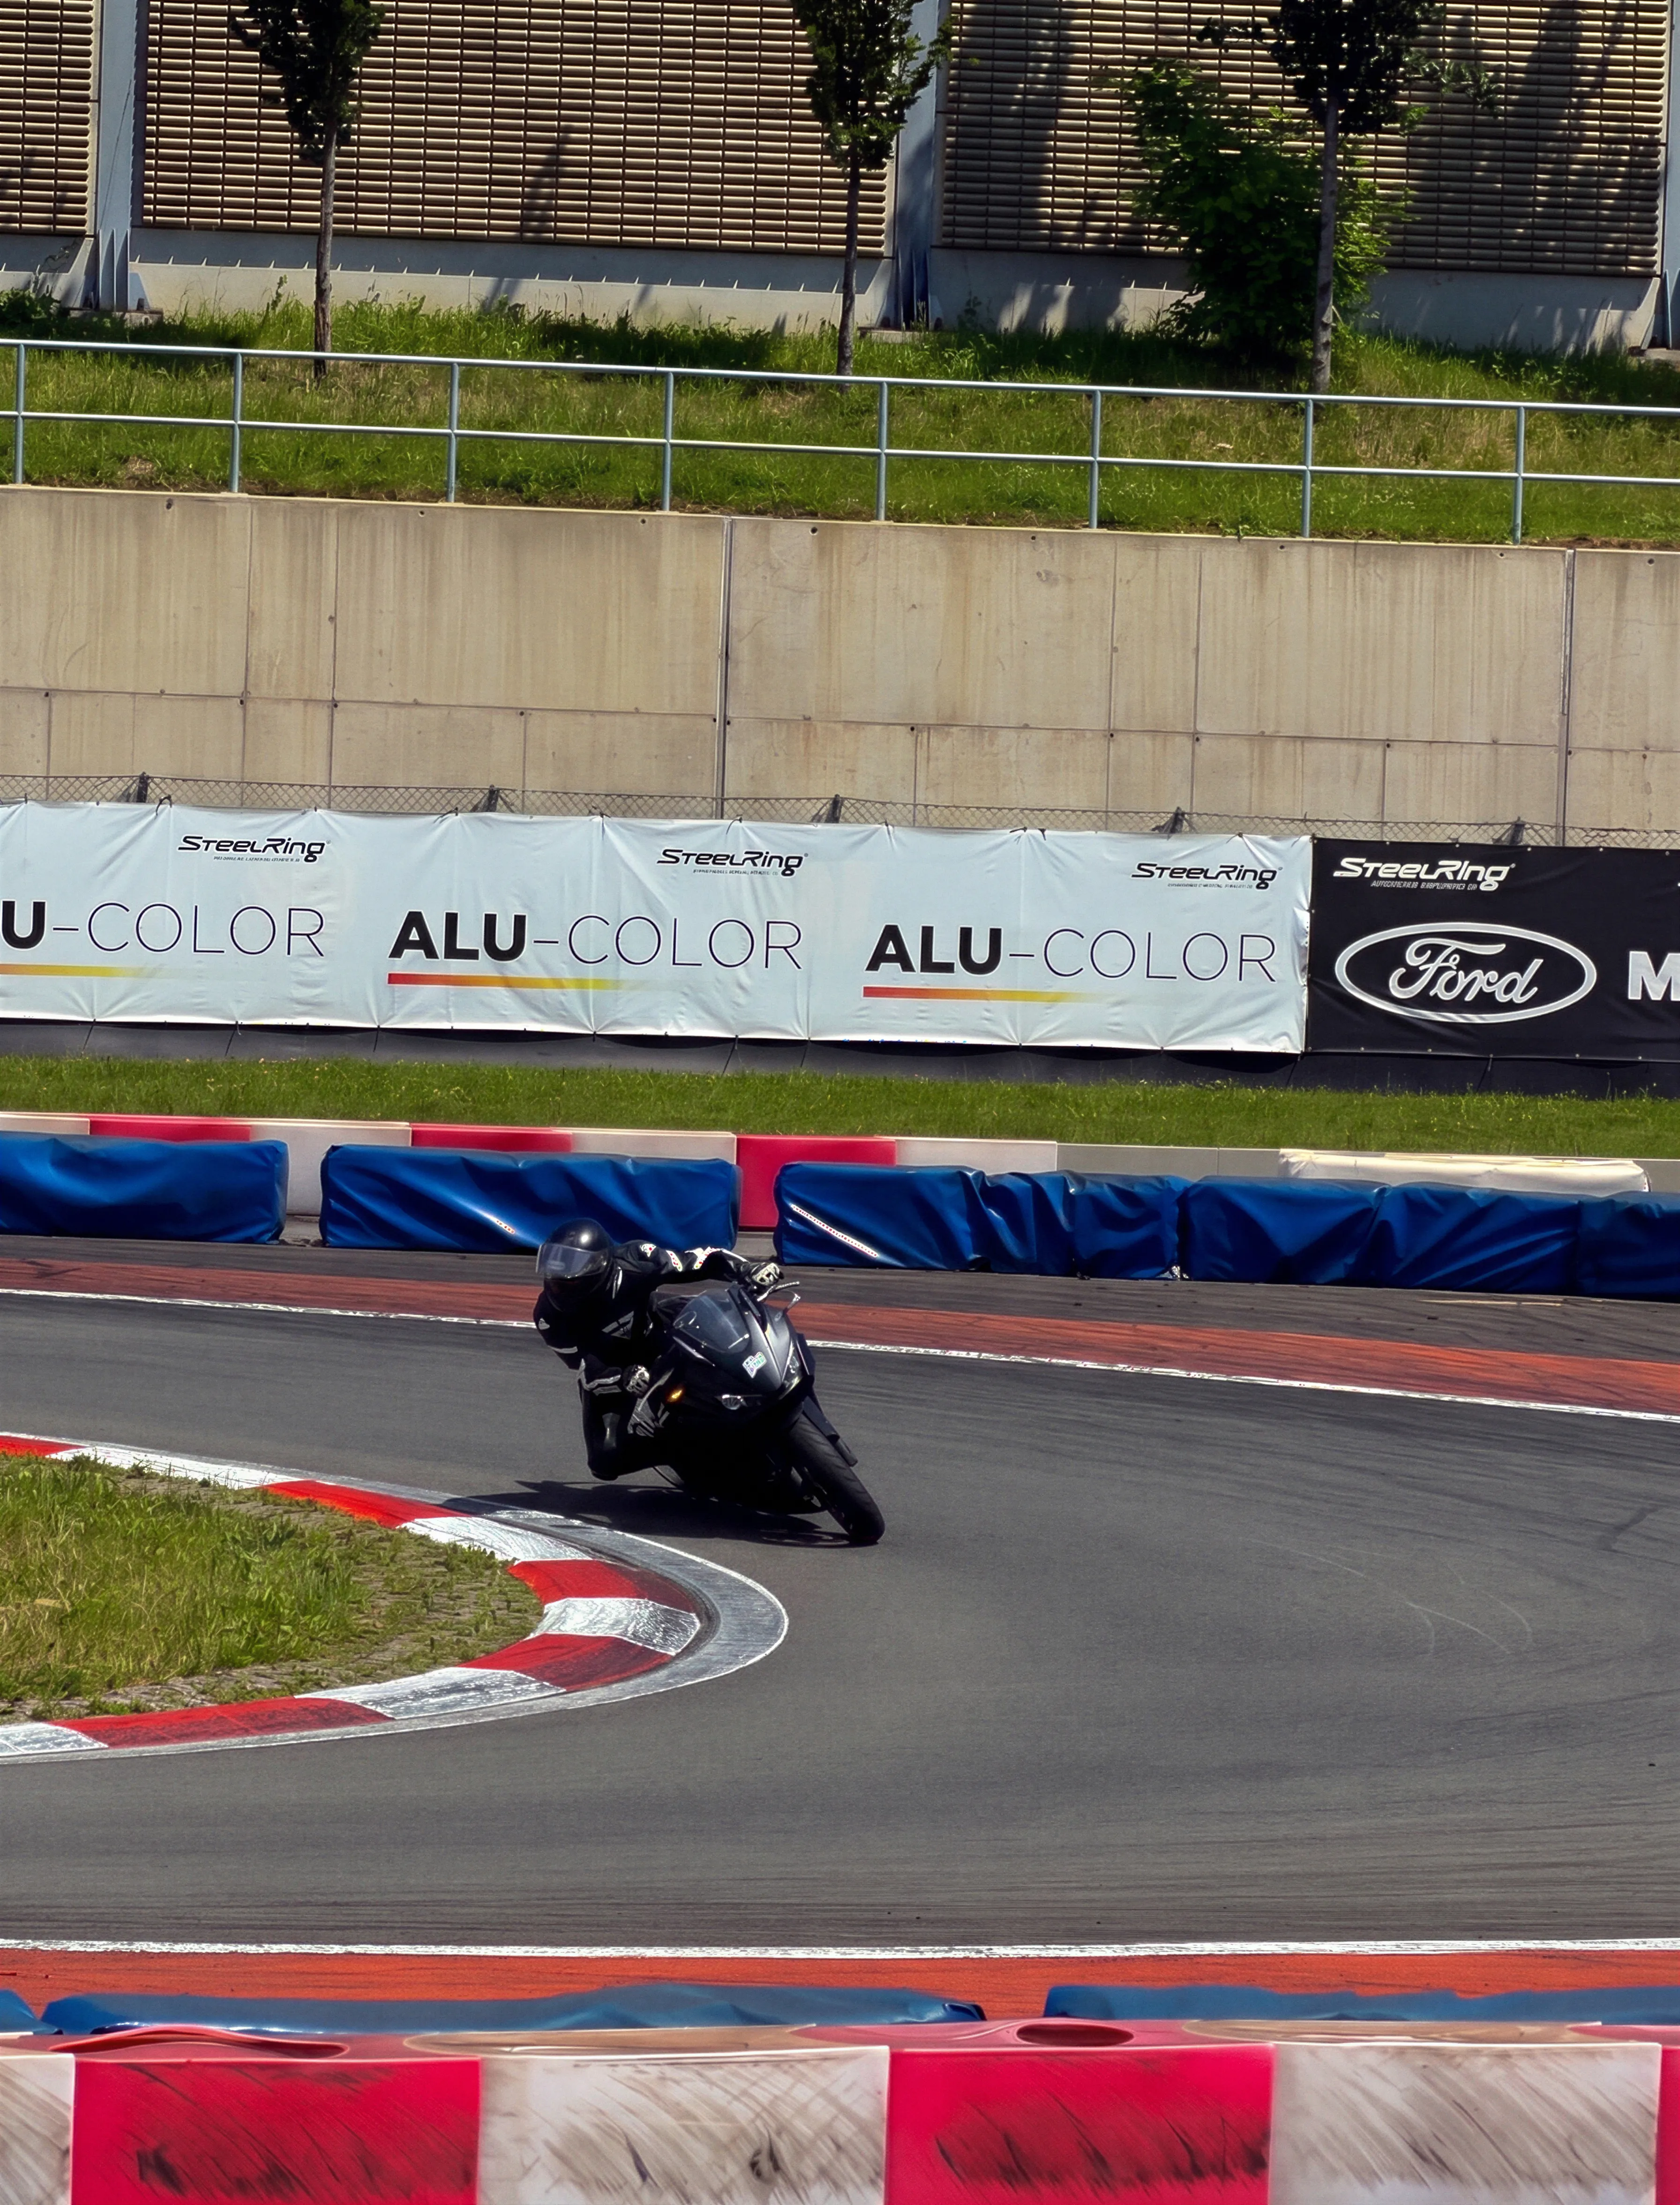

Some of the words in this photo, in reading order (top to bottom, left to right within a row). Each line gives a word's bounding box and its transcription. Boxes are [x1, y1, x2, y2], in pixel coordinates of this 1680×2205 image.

[388, 911, 802, 969] ALU-COLOR
[865, 924, 1275, 982] ALU-COLOR
[1389, 938, 1544, 1004] Ford
